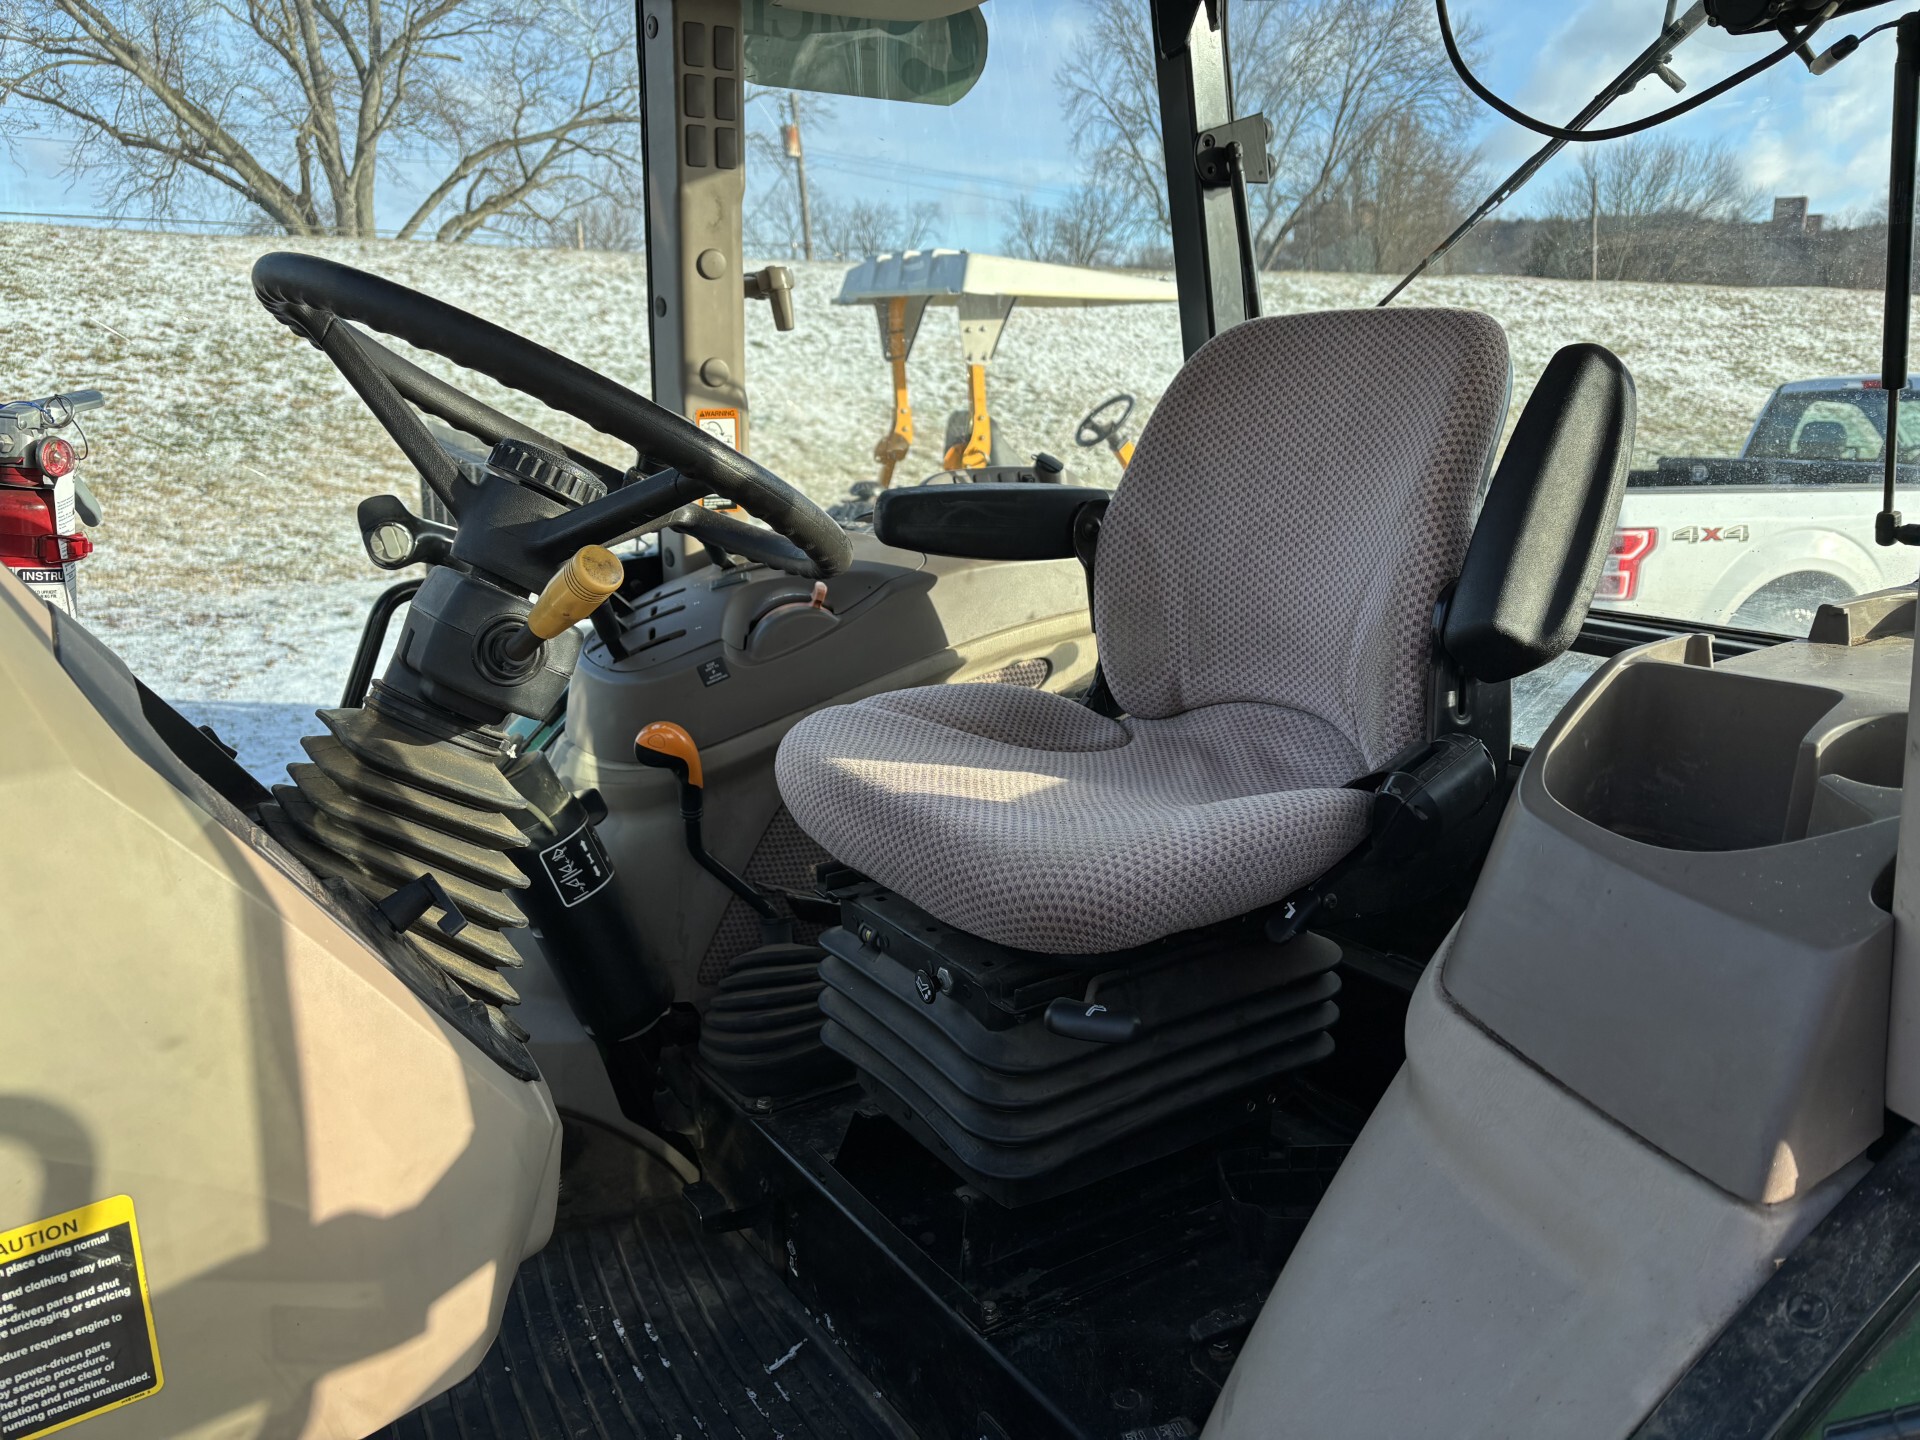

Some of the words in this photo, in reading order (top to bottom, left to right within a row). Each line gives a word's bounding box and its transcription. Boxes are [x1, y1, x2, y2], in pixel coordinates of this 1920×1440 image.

[6, 1259, 36, 1277] place
[37, 1247, 72, 1264] during
[73, 1232, 110, 1252] normal
[1, 1286, 23, 1301] and
[24, 1272, 68, 1293] clothing
[69, 1262, 96, 1278] away
[97, 1254, 121, 1268] from
[46, 1295, 74, 1312] parts
[75, 1285, 96, 1300] and
[97, 1277, 120, 1293] shut
[9, 1308, 71, 1335] unclogging
[71, 1303, 83, 1314] or
[84, 1286, 131, 1309] servicing
[29, 1330, 74, 1352] requires
[74, 1318, 110, 1336] engine
[111, 1313, 123, 1323] to
[12, 1374, 52, 1395] service
[53, 1354, 109, 1381] procedure.
[14, 1351, 83, 1384] power-driven
[84, 1341, 112, 1358] parts
[20, 1384, 57, 1405] people
[58, 1377, 76, 1389] are
[77, 1366, 103, 1382] clear
[104, 1360, 115, 1372] of
[1, 1402, 40, 1422] station
[40, 1392, 62, 1407] and
[62, 1376, 110, 1399] machine.
[2, 1411, 46, 1434] running
[46, 1394, 91, 1418] machine
[92, 1371, 151, 1399] unattended.
